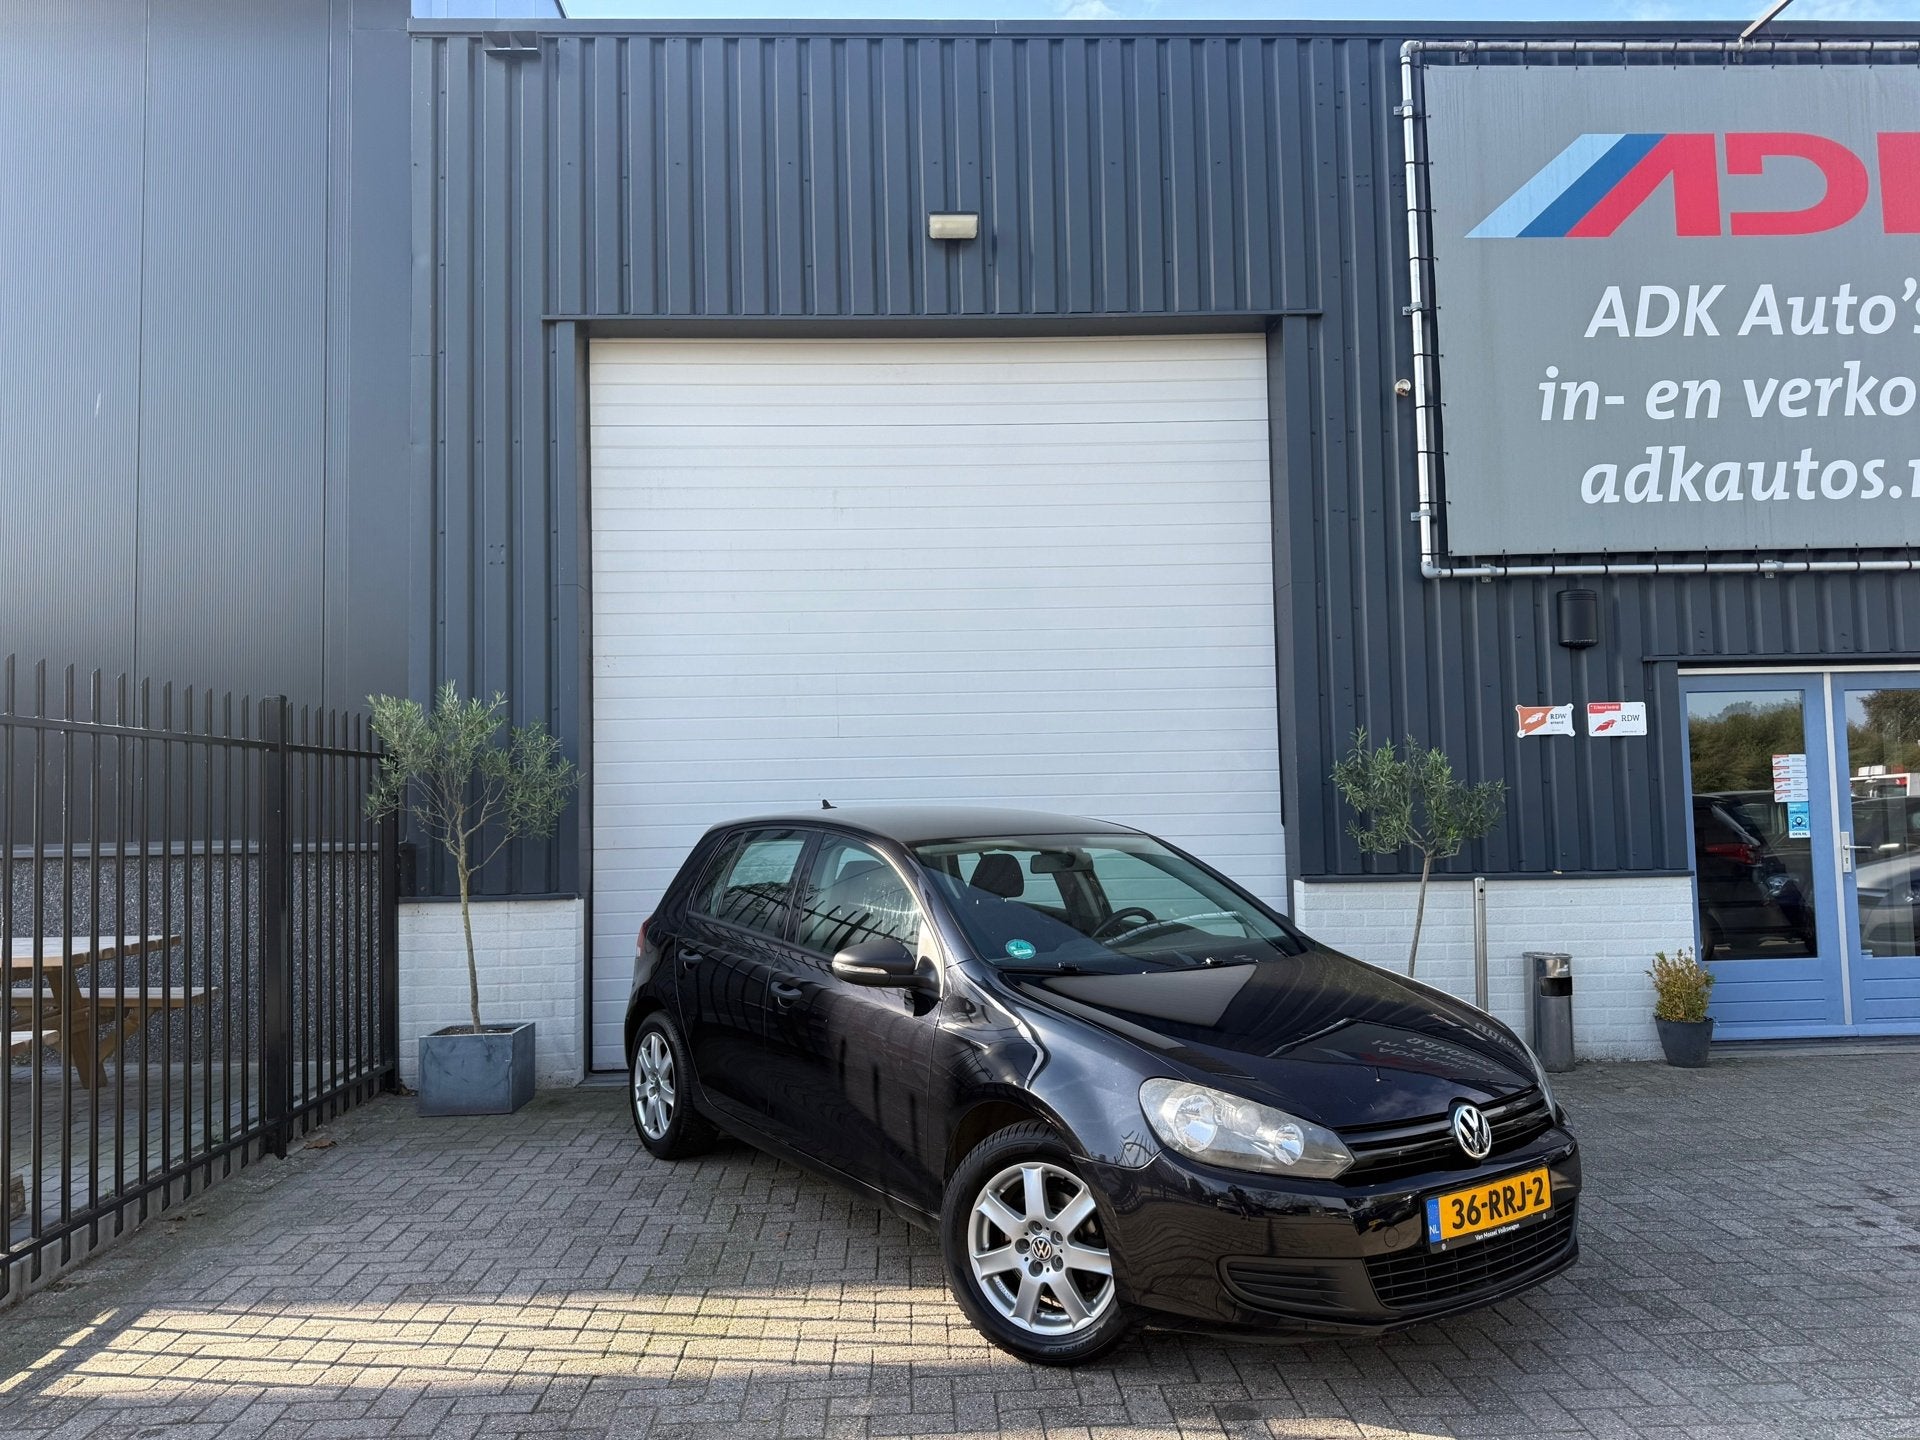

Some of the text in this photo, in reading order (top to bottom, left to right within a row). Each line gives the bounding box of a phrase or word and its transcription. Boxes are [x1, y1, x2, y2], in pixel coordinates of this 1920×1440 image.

[1584, 277, 1920, 338] ADK Auto'
[1538, 360, 1917, 421] in- en verko
[1621, 714, 1641, 722] RDW
[1429, 1224, 1440, 1235] NL
[1451, 1176, 1545, 1230] 36-RRJ-2
